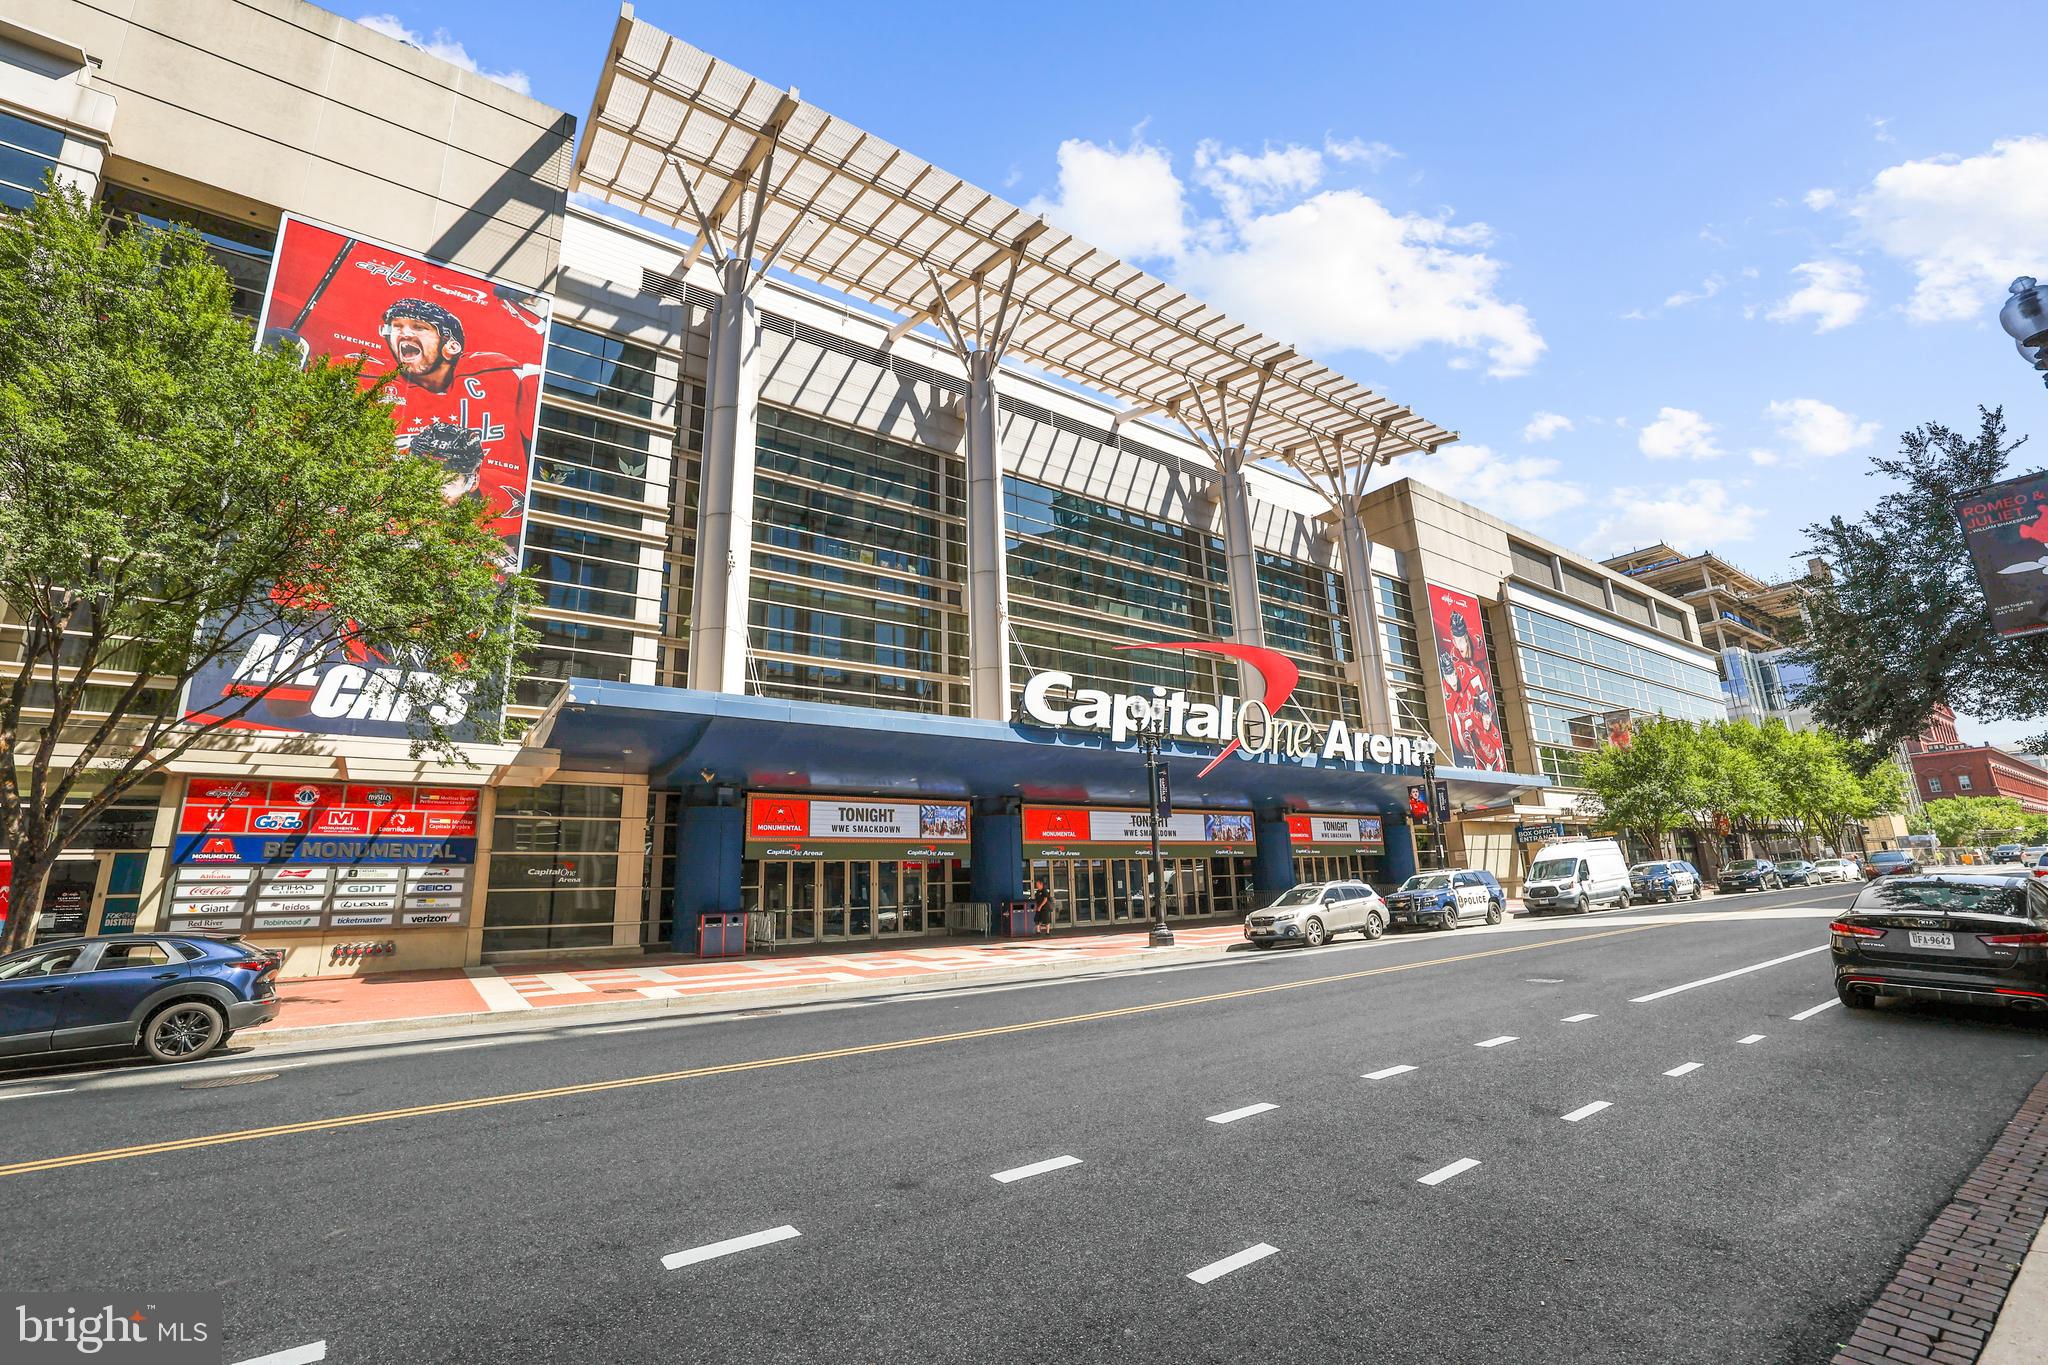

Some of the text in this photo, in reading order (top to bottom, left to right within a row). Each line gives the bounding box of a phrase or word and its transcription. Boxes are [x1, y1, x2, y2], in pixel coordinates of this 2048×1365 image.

[356, 260, 417, 286] capitals
[333, 332, 382, 350] OVECHKIN
[464, 377, 486, 400] C
[487, 459, 520, 471] WILSON
[1963, 490, 2046, 518] ROMEO &
[1967, 507, 2024, 529] JULIET
[231, 633, 328, 688] ALL
[310, 664, 478, 727] CAPS
[1023, 670, 1233, 743] Capital
[1236, 699, 1312, 759] One
[838, 807, 895, 823] TONIGHT
[757, 824, 802, 832] MONUMENTAL
[831, 824, 901, 834] WWE SMACKDOWN
[1322, 821, 1348, 832] TONIGHT
[1123, 829, 1138, 837] WWE
[1518, 830, 1532, 838] BOX
[1533, 828, 1557, 836] OFFICE
[263, 841, 457, 860] BE MONUMENTAL
[528, 868, 561, 877] Capital
[347, 885, 386, 893] GDIT
[416, 884, 453, 892] GEICO
[1463, 895, 1487, 906] POLICE
[200, 903, 230, 913] Giant
[282, 903, 311, 911] leidos
[187, 919, 224, 928] Red River
[263, 918, 302, 926] Robinhood
[337, 916, 384, 925] ticketmaster
[411, 914, 448, 924] verizon
